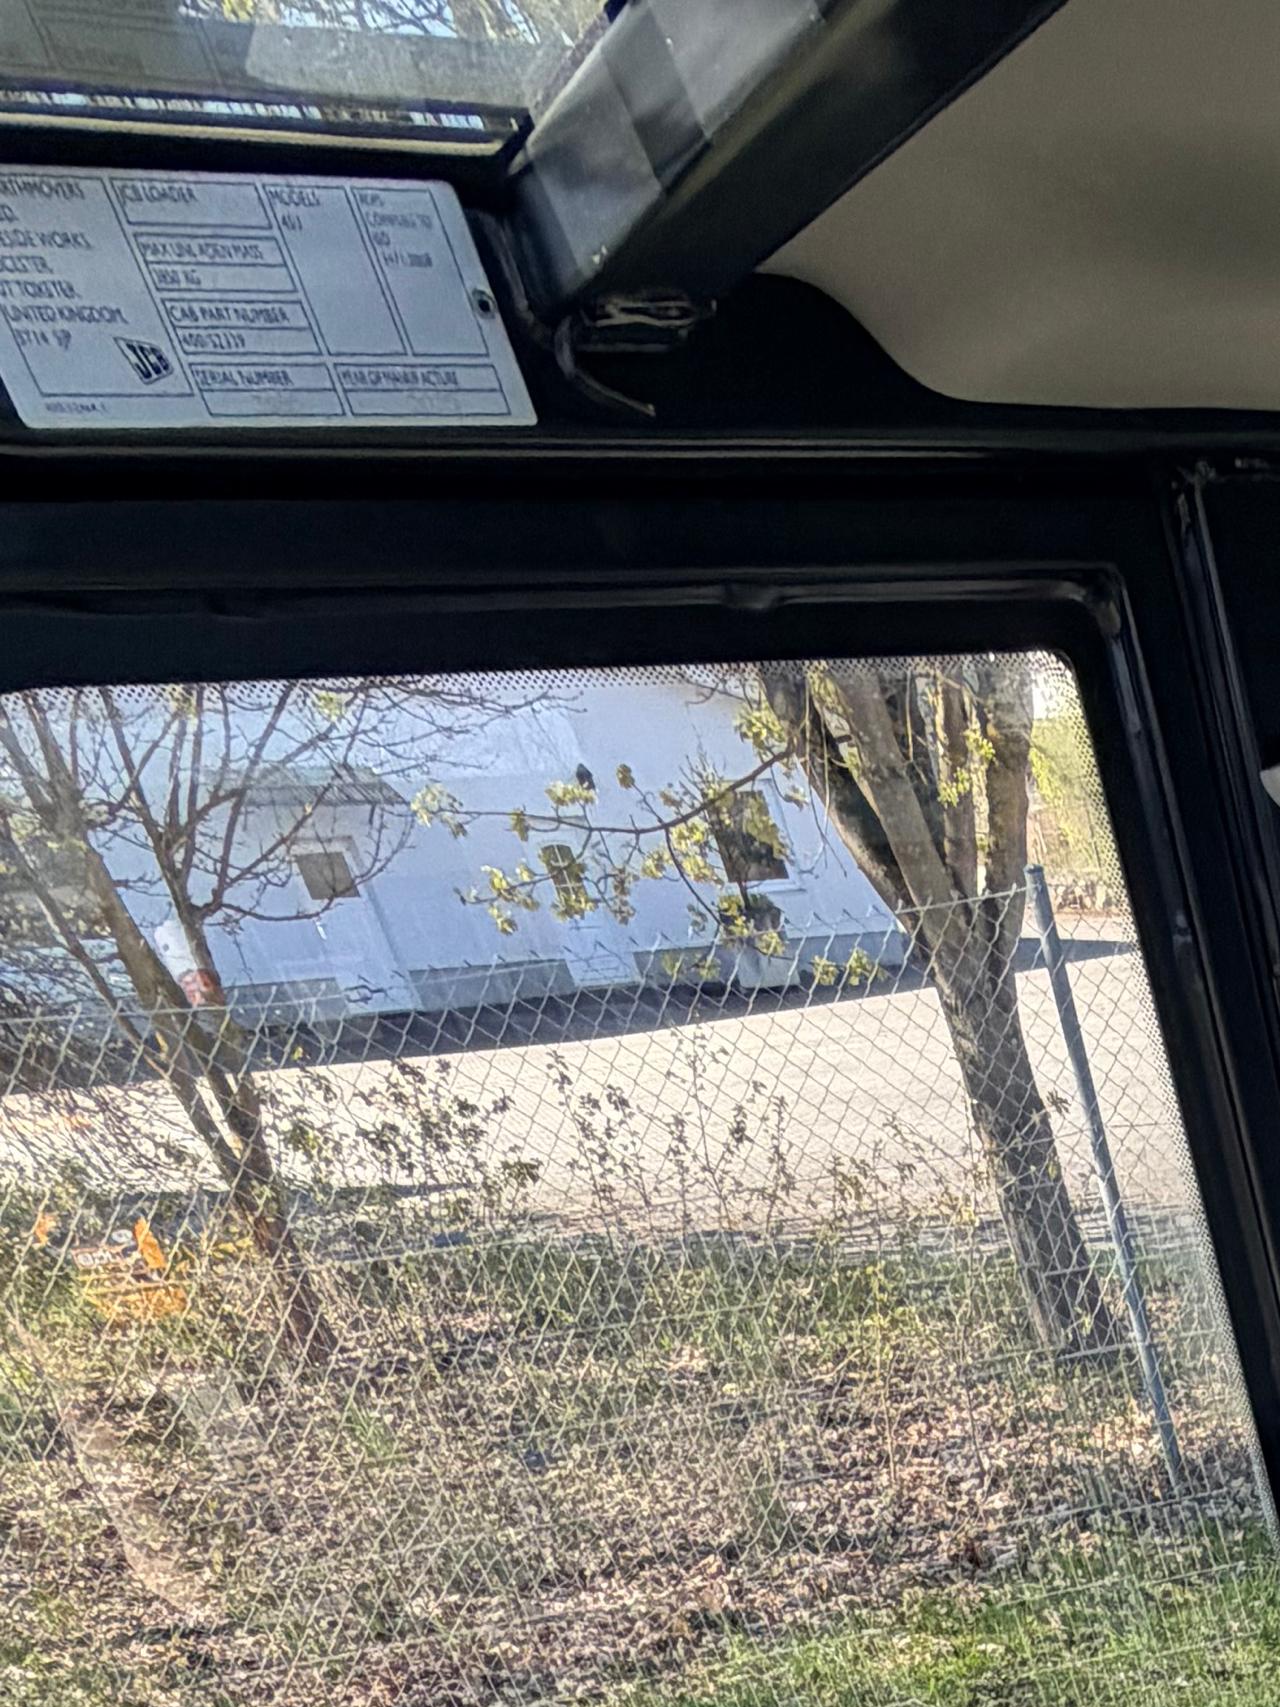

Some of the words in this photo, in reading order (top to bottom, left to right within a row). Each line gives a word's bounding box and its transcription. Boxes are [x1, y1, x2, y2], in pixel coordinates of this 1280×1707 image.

[169, 305, 199, 322] CAB
[200, 306, 233, 321] PART
[234, 307, 290, 324] NUMBER
[126, 342, 170, 379] JCB
[238, 370, 295, 387] NUMBER
